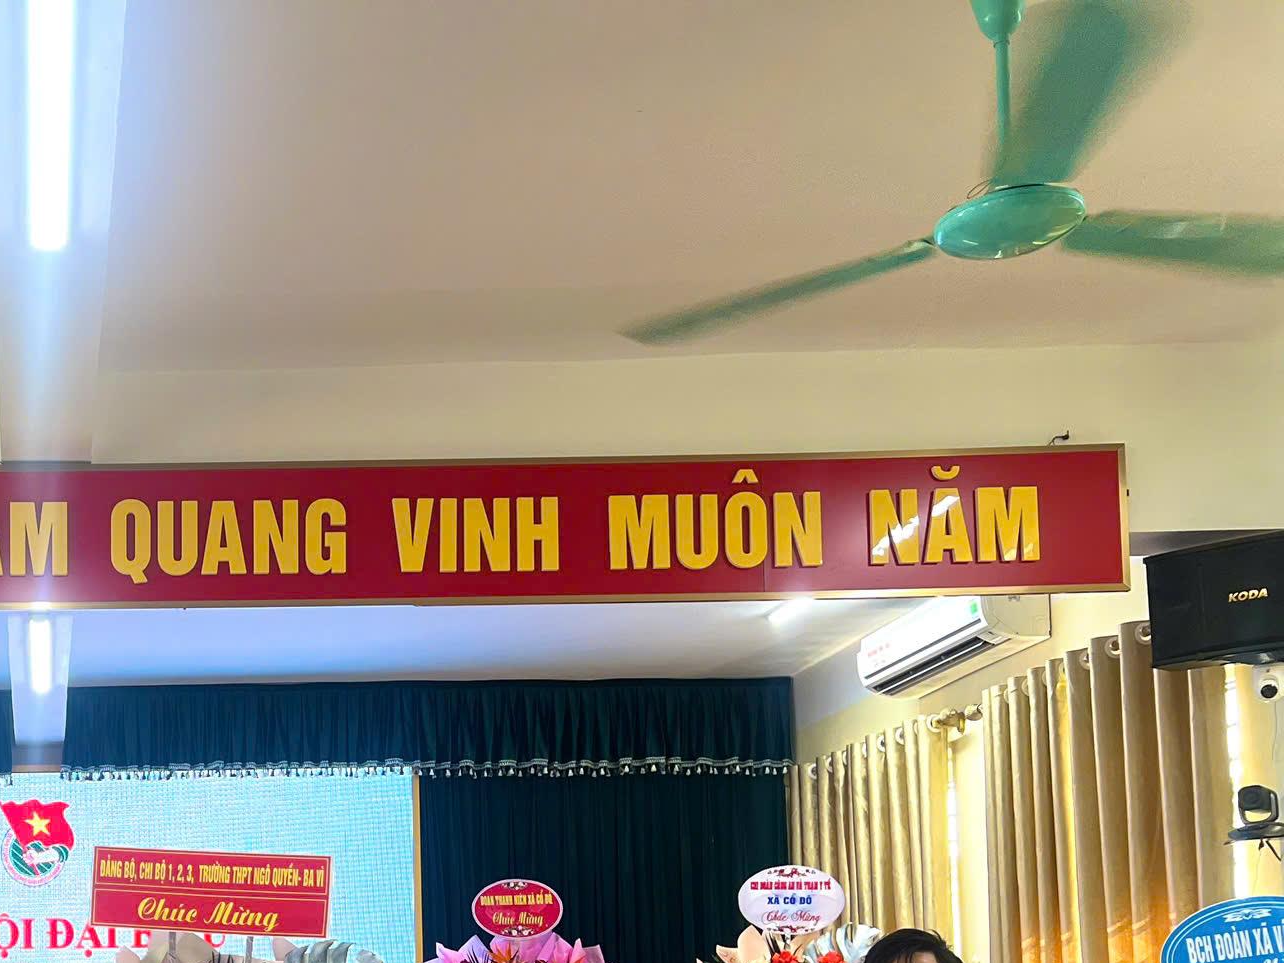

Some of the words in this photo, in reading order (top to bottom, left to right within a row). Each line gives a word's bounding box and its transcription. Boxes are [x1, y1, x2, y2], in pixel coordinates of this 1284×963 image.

[110, 500, 347, 582] QUANG
[393, 497, 560, 573] VINH
[609, 469, 823, 570] MUÔN
[869, 465, 1040, 565] NĂM
[1228, 588, 1268, 603] KODA
[100, 854, 122, 878] ĐẢNG
[139, 861, 153, 880] CHI
[155, 859, 166, 884] BỘ
[233, 866, 252, 884] THPT
[254, 863, 271, 886] NGÔ
[303, 868, 314, 887] BA
[137, 896, 197, 923] Chúc
[204, 900, 279, 932] Mừng
[1214, 925, 1253, 961] ĐOÀN
[1252, 922, 1274, 956] XÃ
